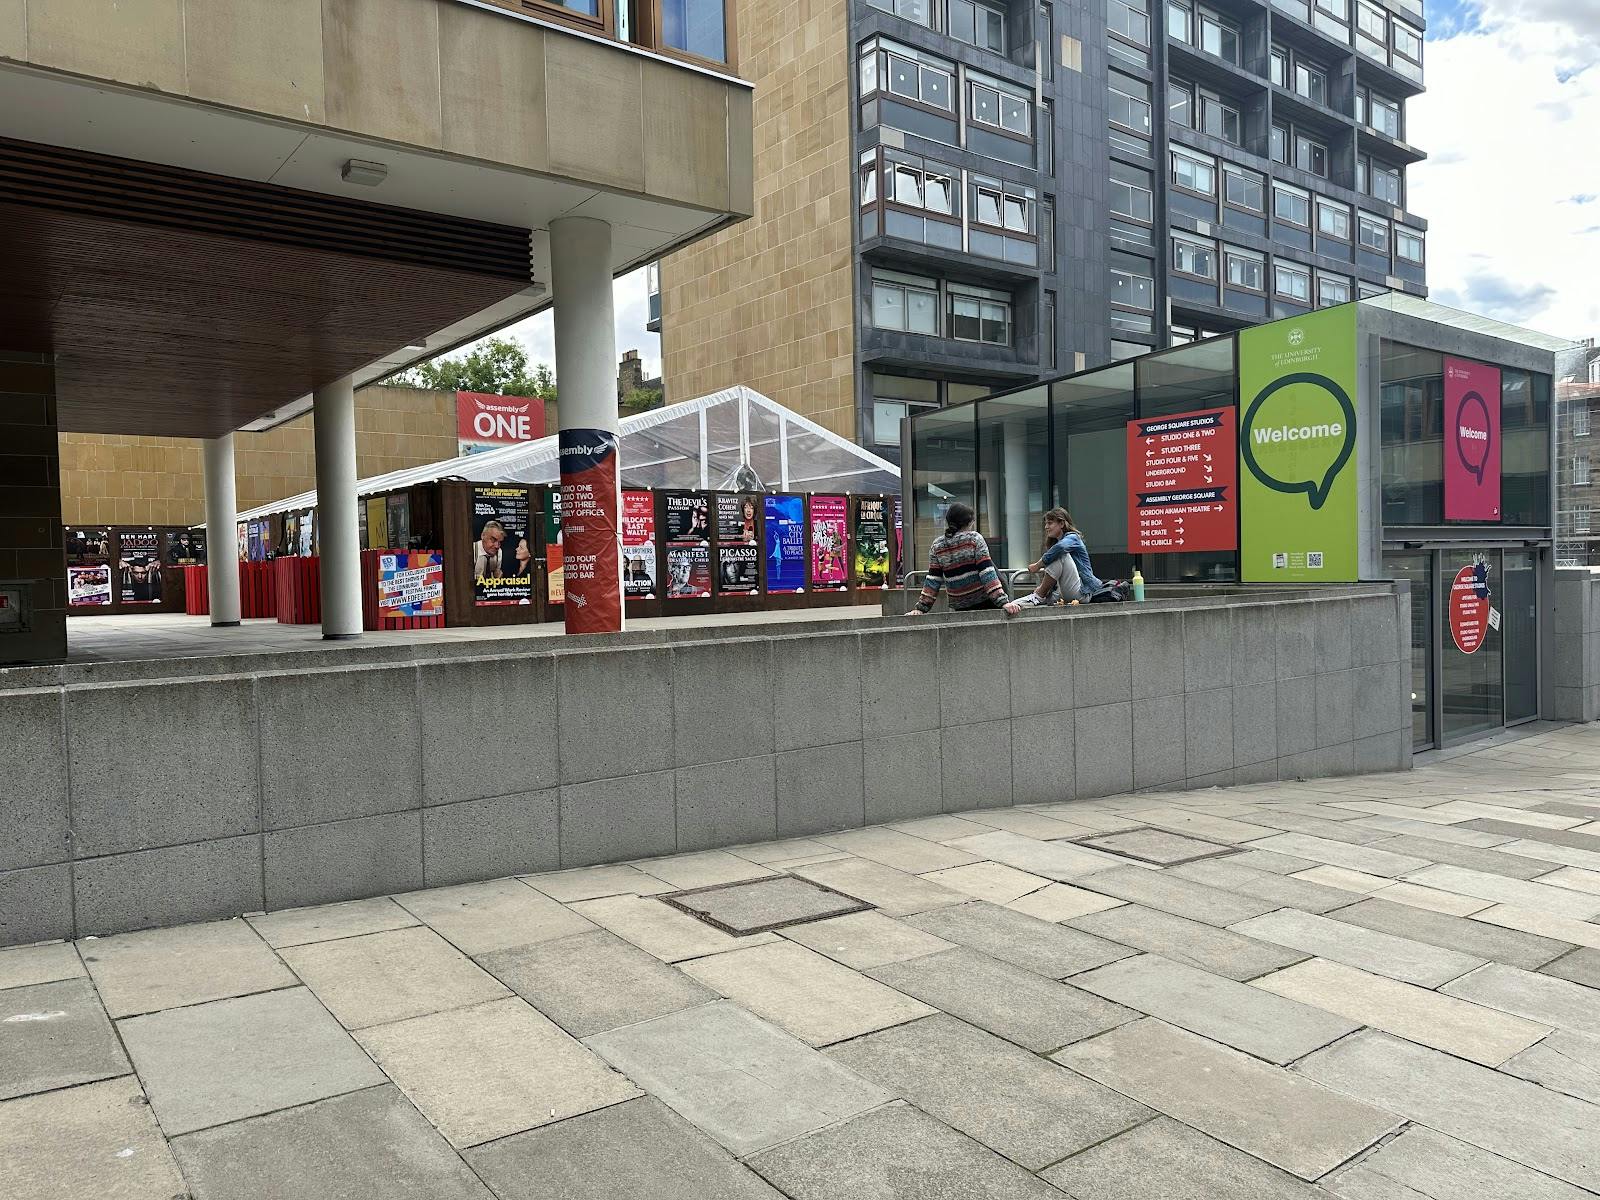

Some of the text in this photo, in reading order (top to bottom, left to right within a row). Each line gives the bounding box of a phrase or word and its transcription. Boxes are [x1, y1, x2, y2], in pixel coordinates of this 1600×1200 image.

[1284, 346, 1321, 357] UNIVERSITY
[1280, 354, 1318, 366] EDINBURGH
[486, 404, 519, 413] assembly
[474, 412, 531, 440] ONE
[1146, 417, 1214, 432] GEORGE SQUARE STUDIOS
[1254, 421, 1342, 444] Welcome
[1459, 426, 1487, 440] Welcome
[1161, 434, 1181, 442] STUDIO
[1161, 446, 1182, 454] STUDIO
[1146, 458, 1165, 466] STUDIO
[1146, 467, 1186, 477] UNDERGROUND
[576, 484, 592, 492] ONE
[576, 492, 594, 500] TWO
[1145, 495, 1171, 503] ASSEMBLY
[667, 497, 708, 507] THE DEVIL'S
[860, 501, 883, 511] AFRIQUE
[576, 508, 605, 516] OFFICES
[1140, 508, 1164, 516] GORDON
[1187, 505, 1210, 513] THEATRE
[866, 511, 883, 520] CIRQUE
[669, 550, 708, 558] MANIFEST
[719, 549, 757, 557] PICASSO
[579, 563, 594, 571] FIVE
[579, 571, 594, 579] BAR
[476, 573, 530, 588] Appraisal
[396, 582, 419, 590] EDINBURGH
